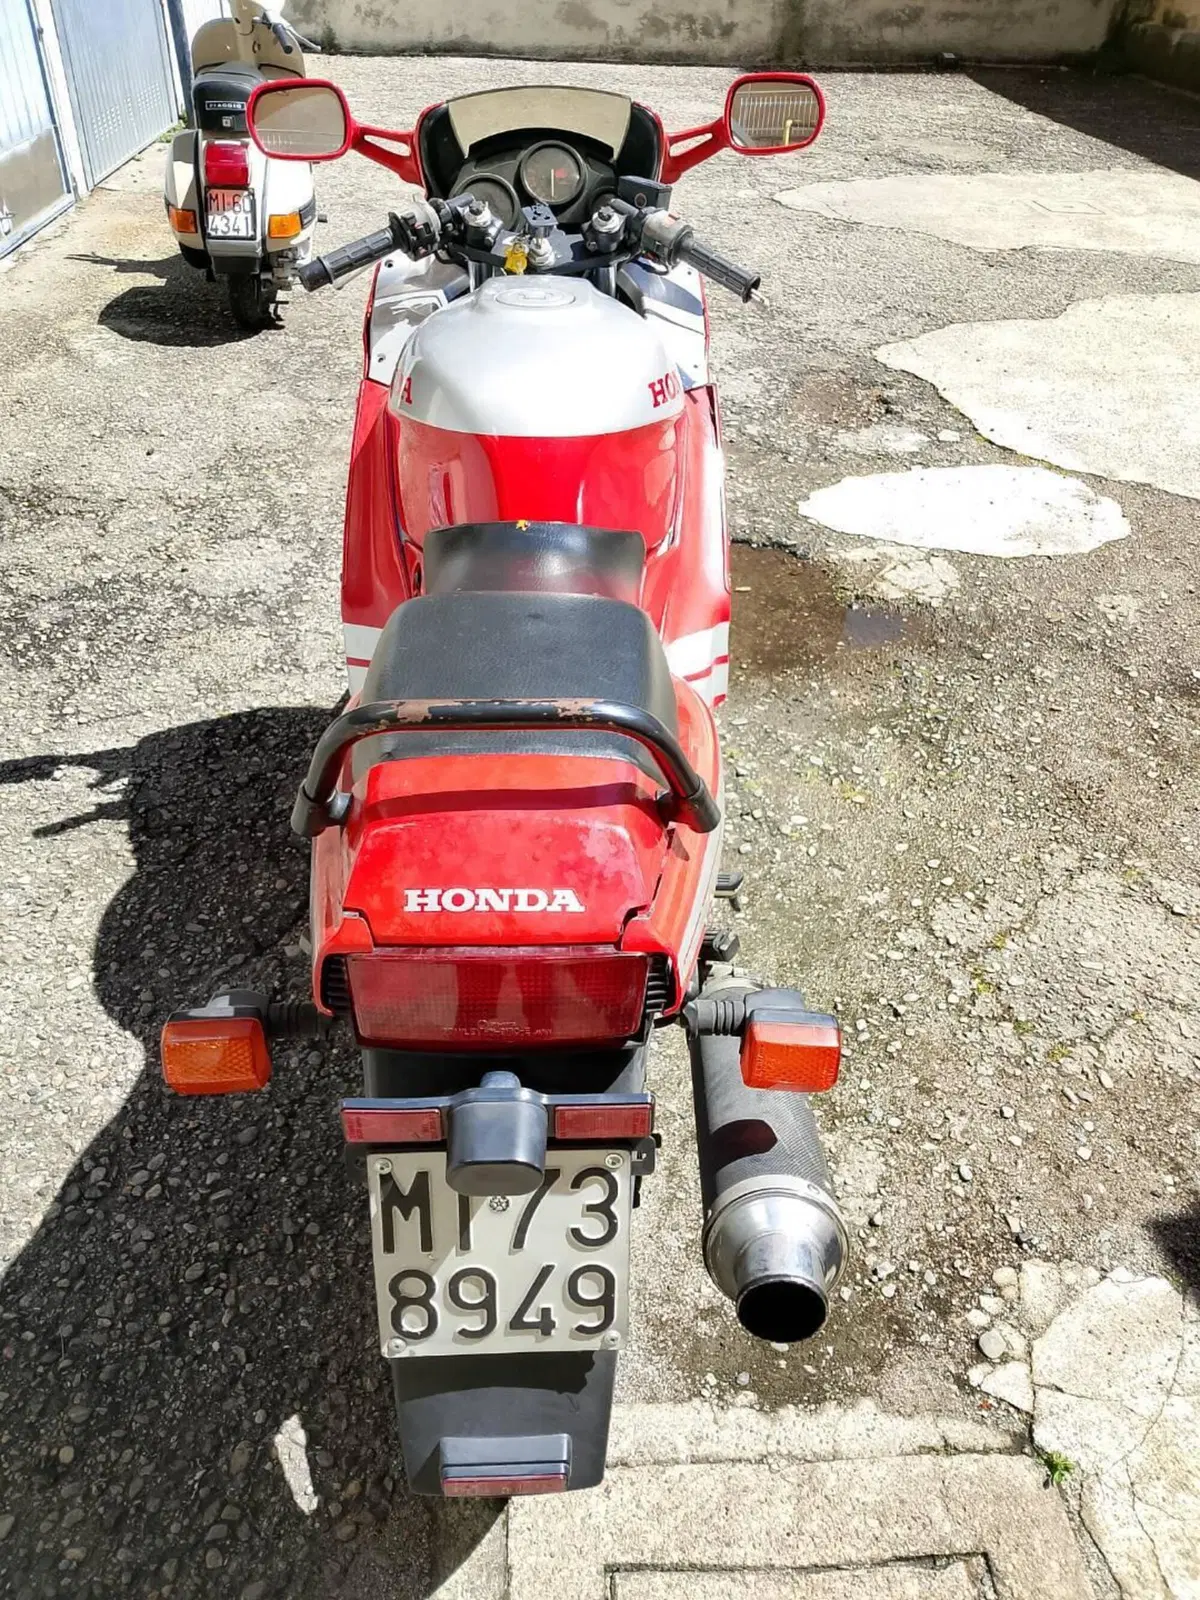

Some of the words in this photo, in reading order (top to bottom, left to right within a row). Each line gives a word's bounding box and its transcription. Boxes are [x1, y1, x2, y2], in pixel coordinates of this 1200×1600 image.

[209, 193, 226, 212] MI
[210, 215, 249, 236] 4341
[403, 888, 585, 912] HONDA
[379, 1170, 472, 1255] MI
[512, 1167, 619, 1248] 73
[388, 1264, 616, 1340] 8949
